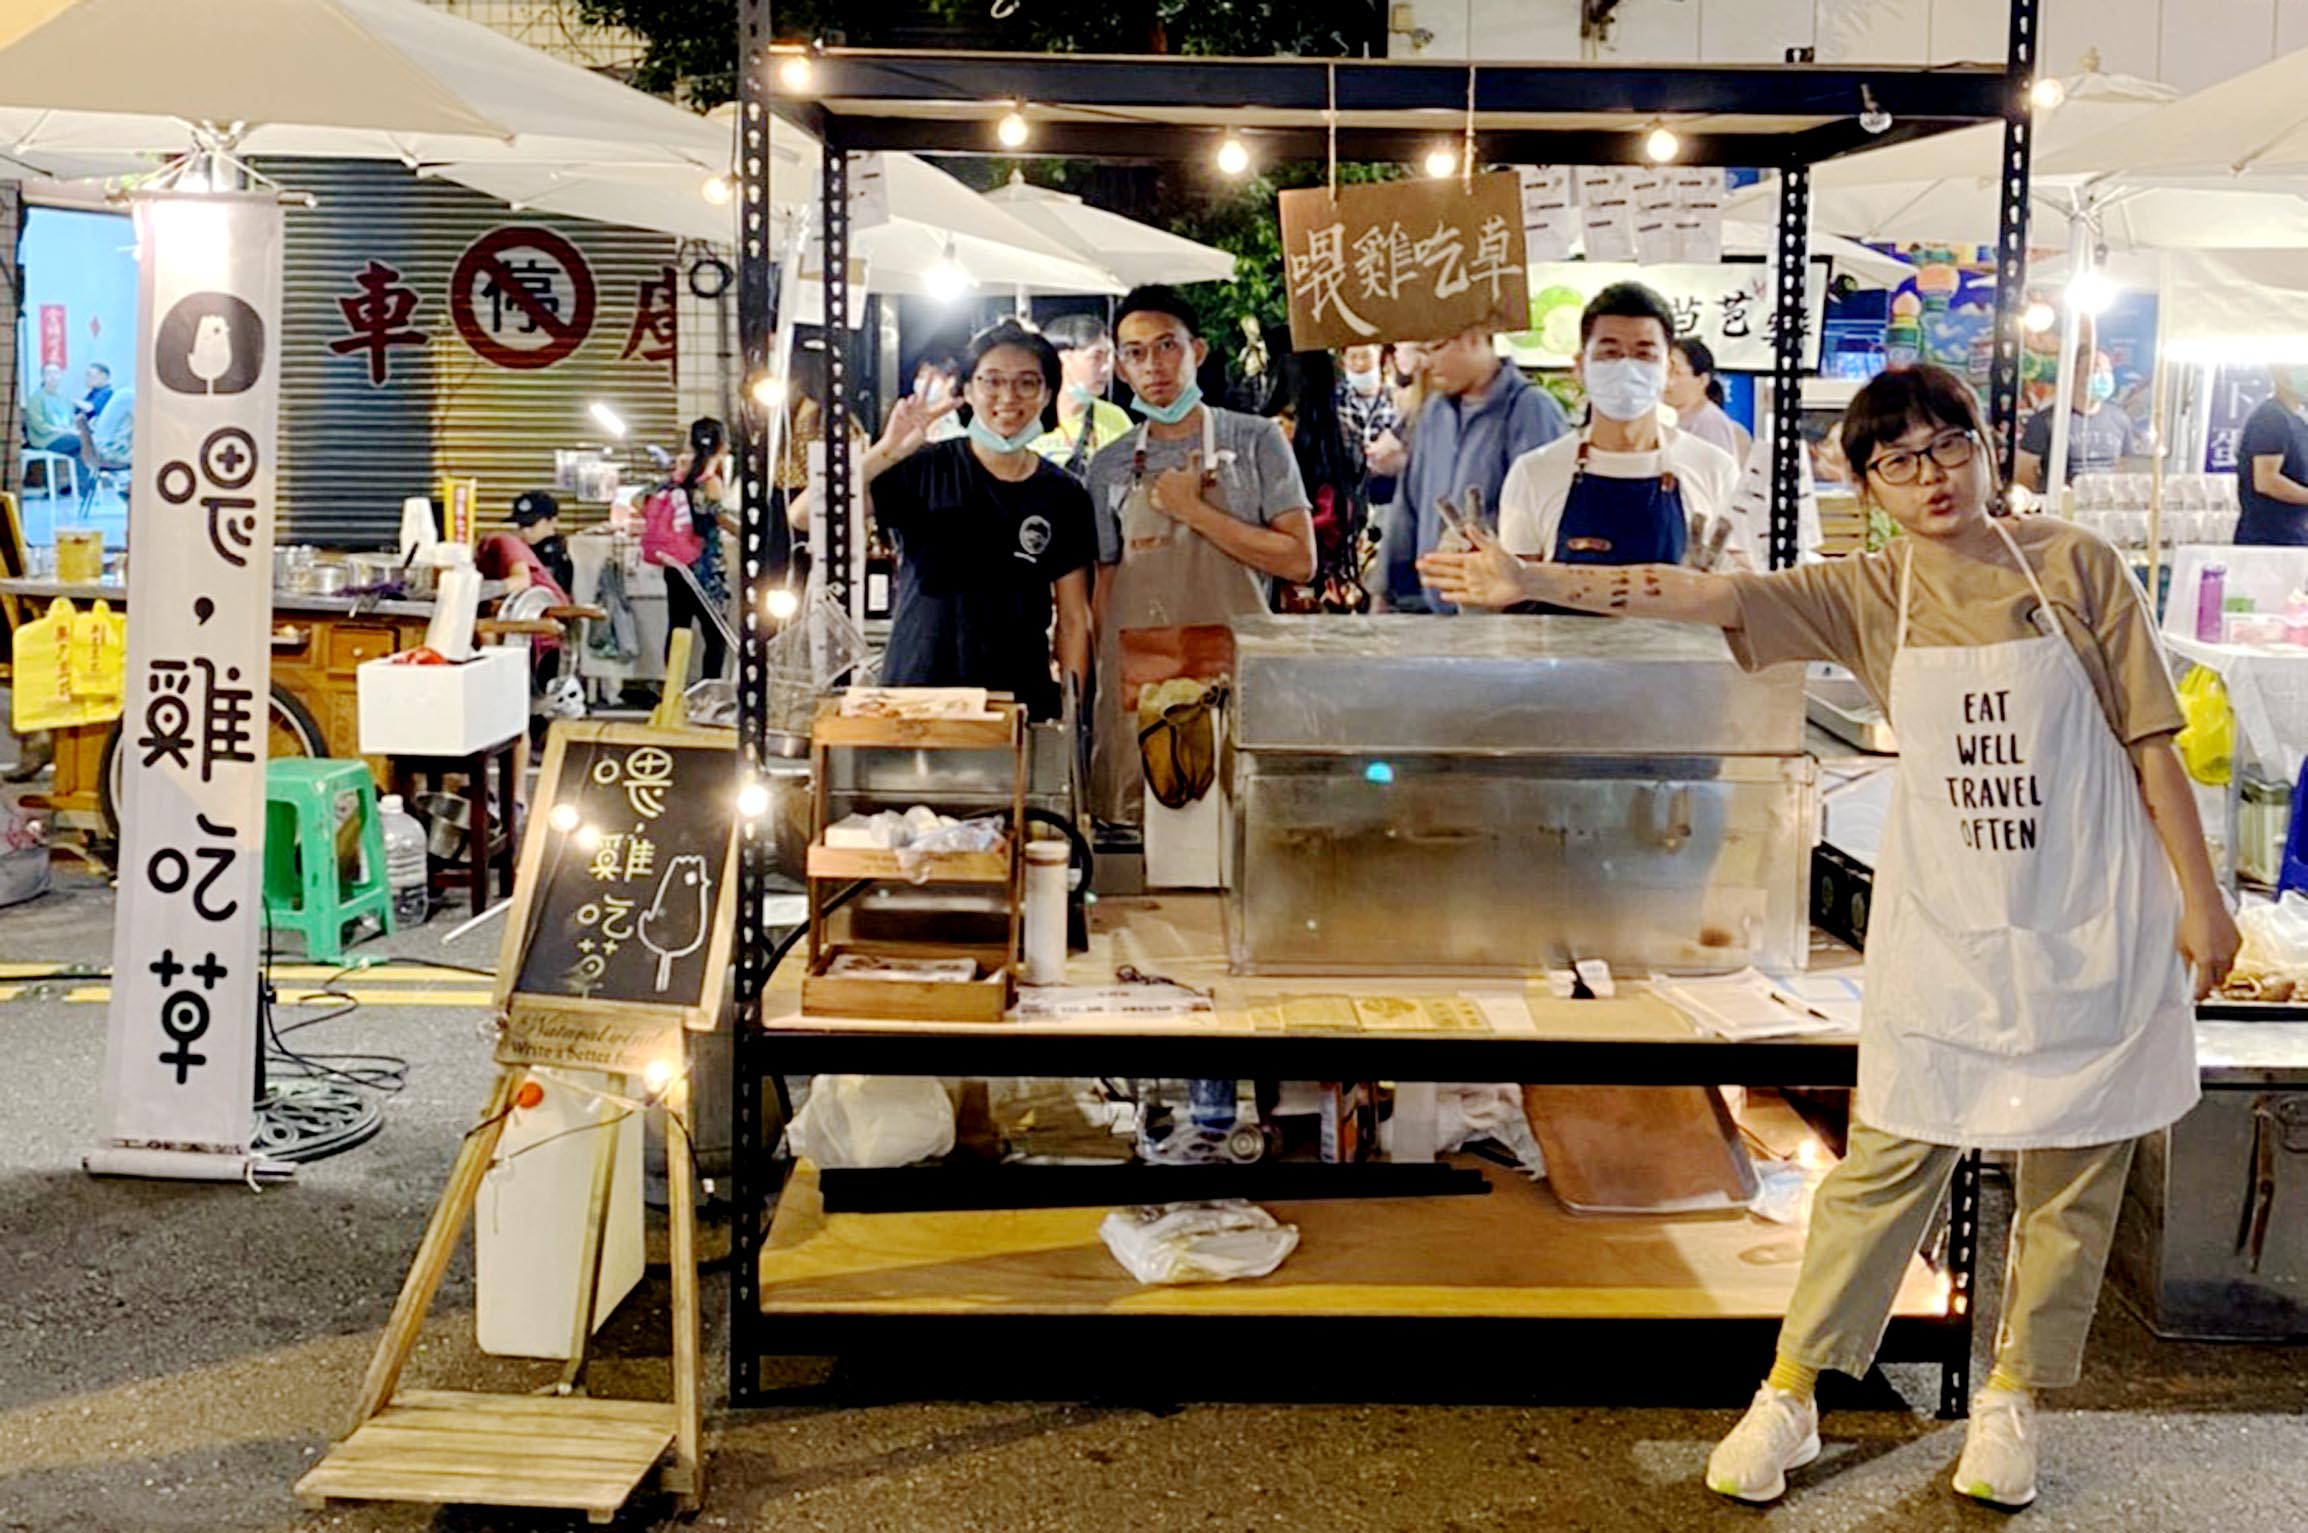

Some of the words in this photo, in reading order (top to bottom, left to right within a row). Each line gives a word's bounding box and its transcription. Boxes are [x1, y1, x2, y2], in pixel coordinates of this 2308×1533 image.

[1290, 214, 1523, 337] 喂雞吃草
[329, 260, 428, 387] 車
[482, 259, 561, 333] 停
[1964, 690, 2009, 723] EAT
[1957, 733, 2023, 765] WELL
[1945, 775, 2042, 808] TRAVEL
[1961, 817, 2036, 850] OFTEN
